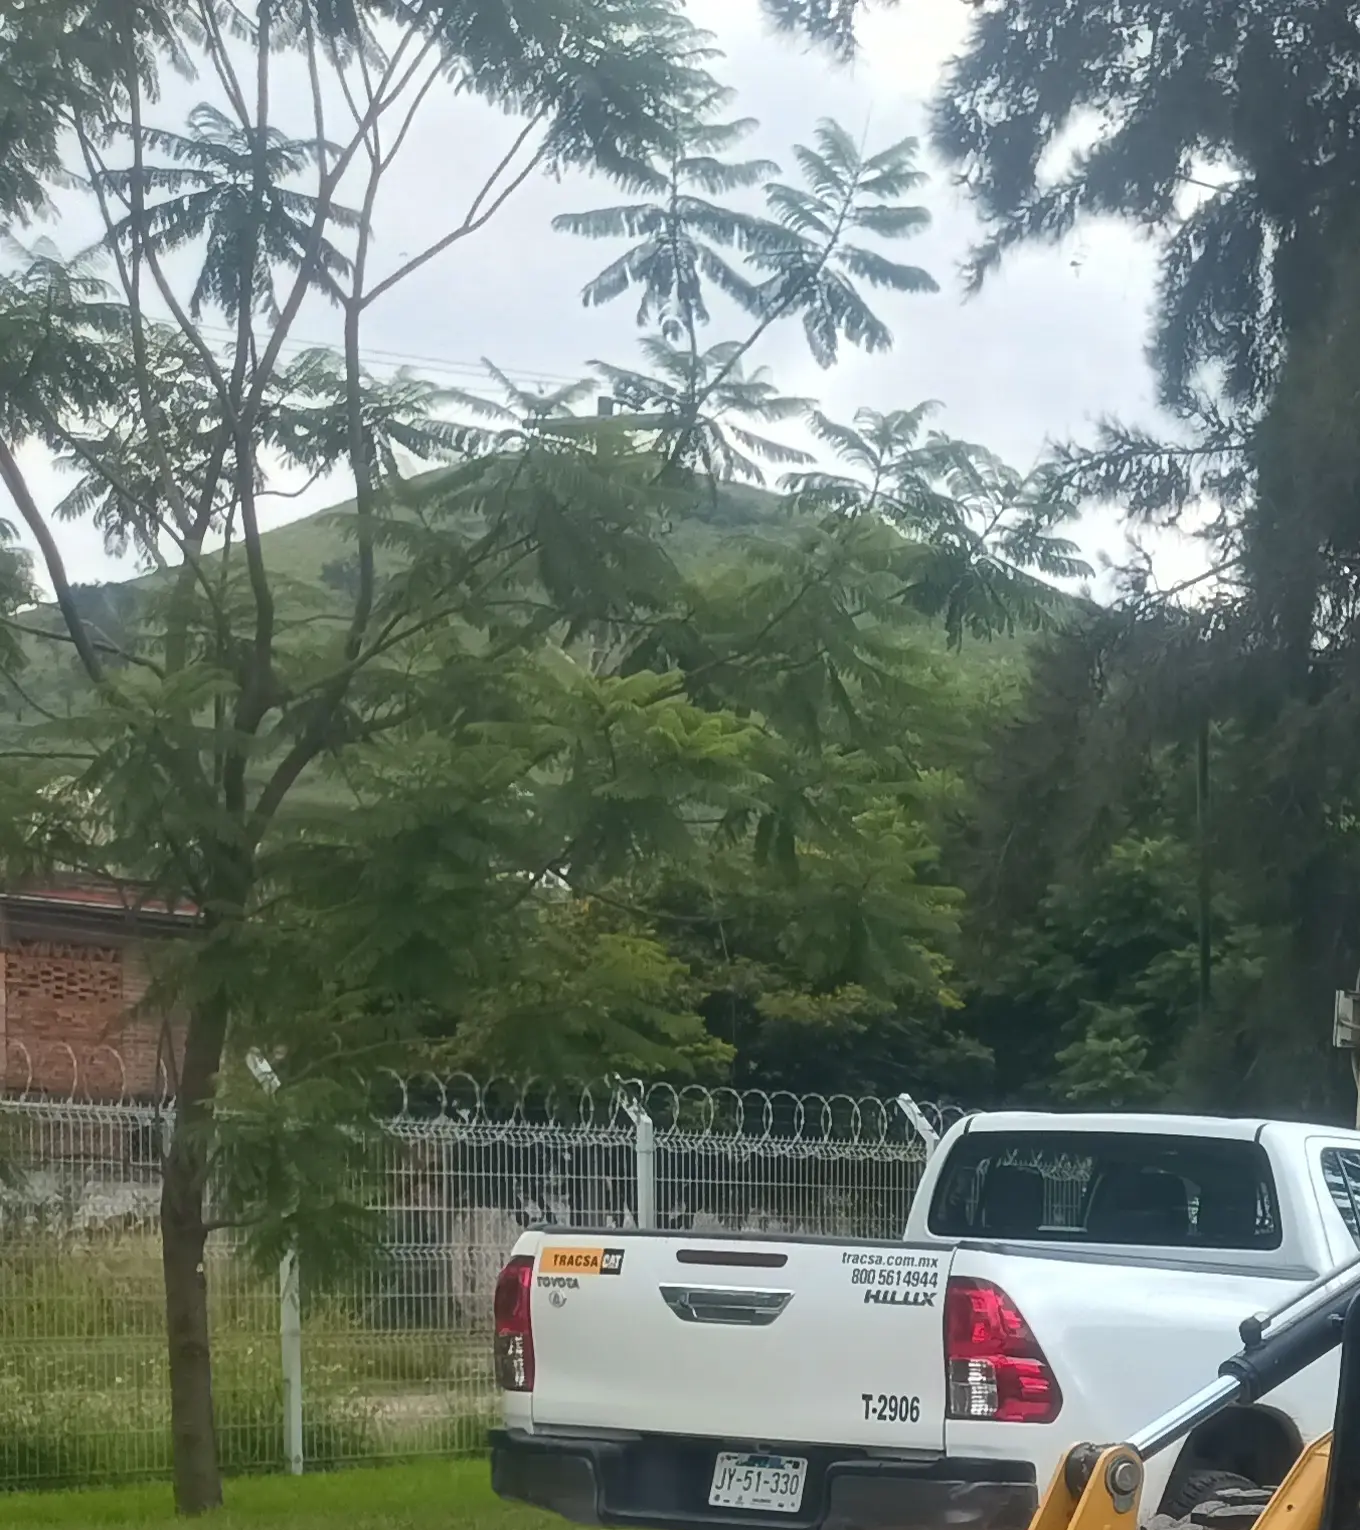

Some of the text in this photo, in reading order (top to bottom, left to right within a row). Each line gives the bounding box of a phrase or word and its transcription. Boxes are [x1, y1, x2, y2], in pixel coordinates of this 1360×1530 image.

[552, 1252, 622, 1269] TRACSA CAT
[841, 1251, 939, 1269] tracsa.com.mx
[536, 1275, 580, 1290] TOYOTA
[851, 1268, 876, 1285] 800
[863, 1288, 938, 1308] HILUX
[714, 1466, 800, 1496] JY-51-330
